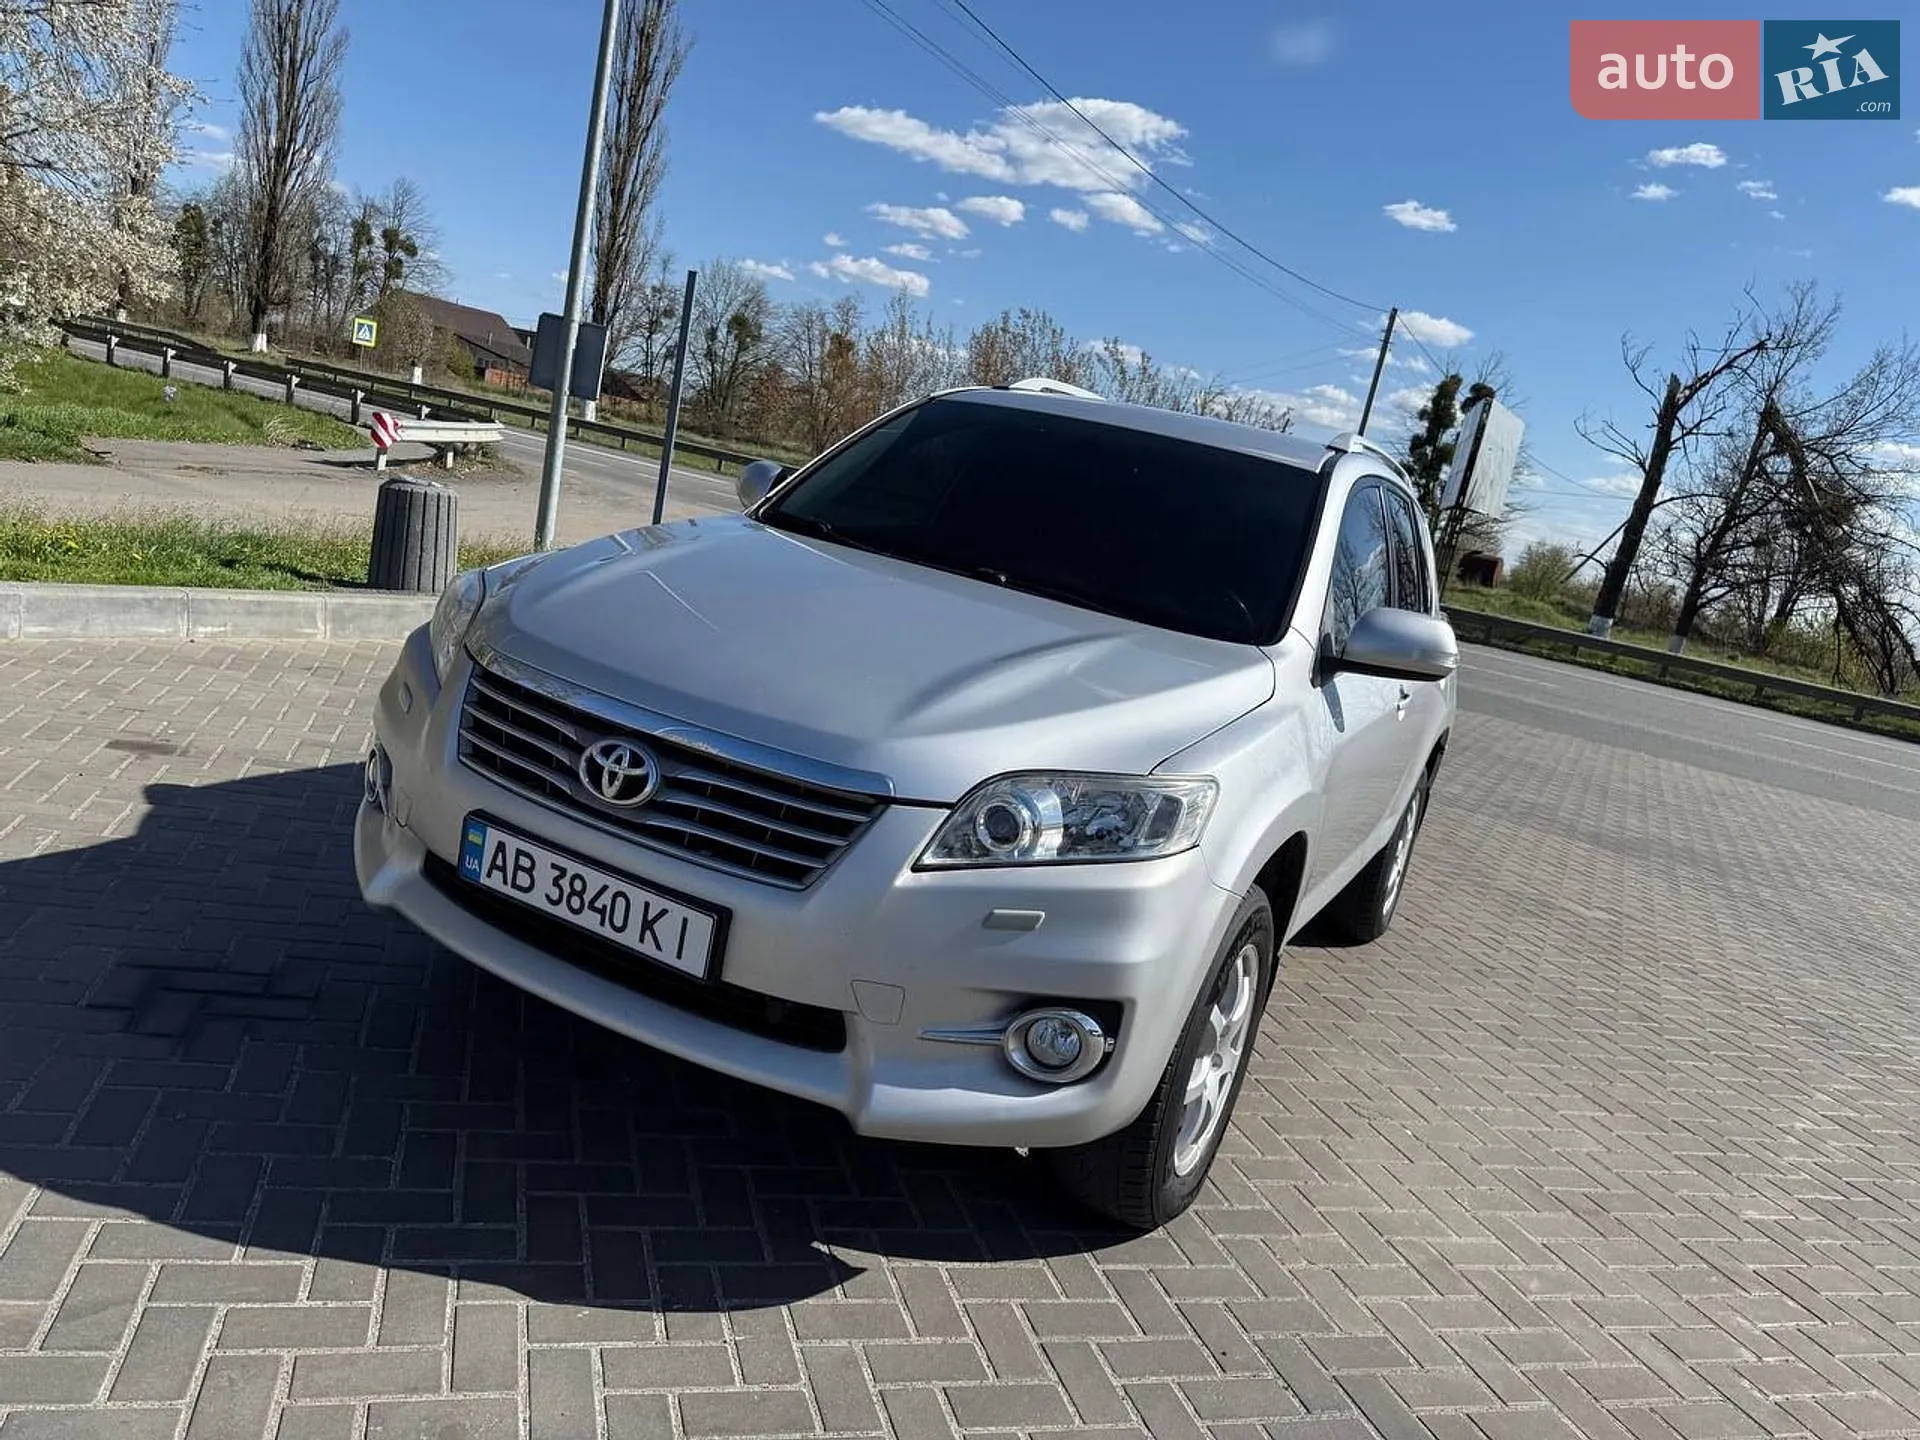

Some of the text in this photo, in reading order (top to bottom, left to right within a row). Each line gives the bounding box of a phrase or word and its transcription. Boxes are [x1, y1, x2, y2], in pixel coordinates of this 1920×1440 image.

[465, 855, 480, 873] UA
[485, 840, 688, 960] AB 3840 KI
